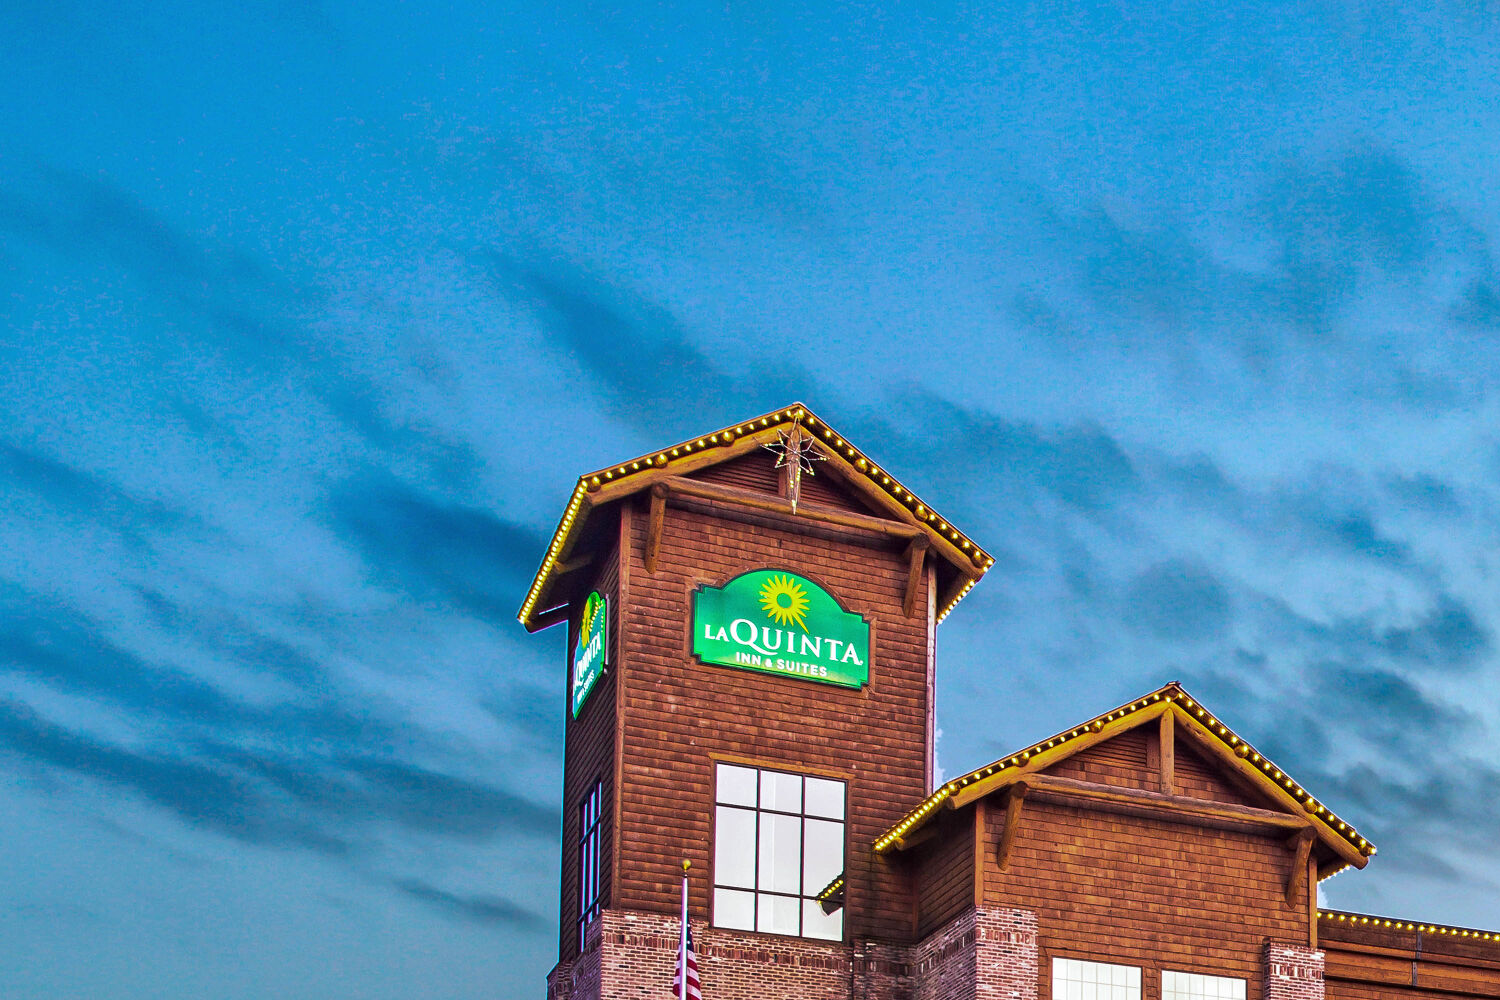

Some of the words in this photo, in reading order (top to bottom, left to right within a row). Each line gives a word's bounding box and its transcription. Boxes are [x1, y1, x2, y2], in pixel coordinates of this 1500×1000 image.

[730, 619, 862, 665] QUINTA
[736, 652, 761, 665] INN
[765, 658, 773, 668] &
[777, 659, 827, 677] SUITES
